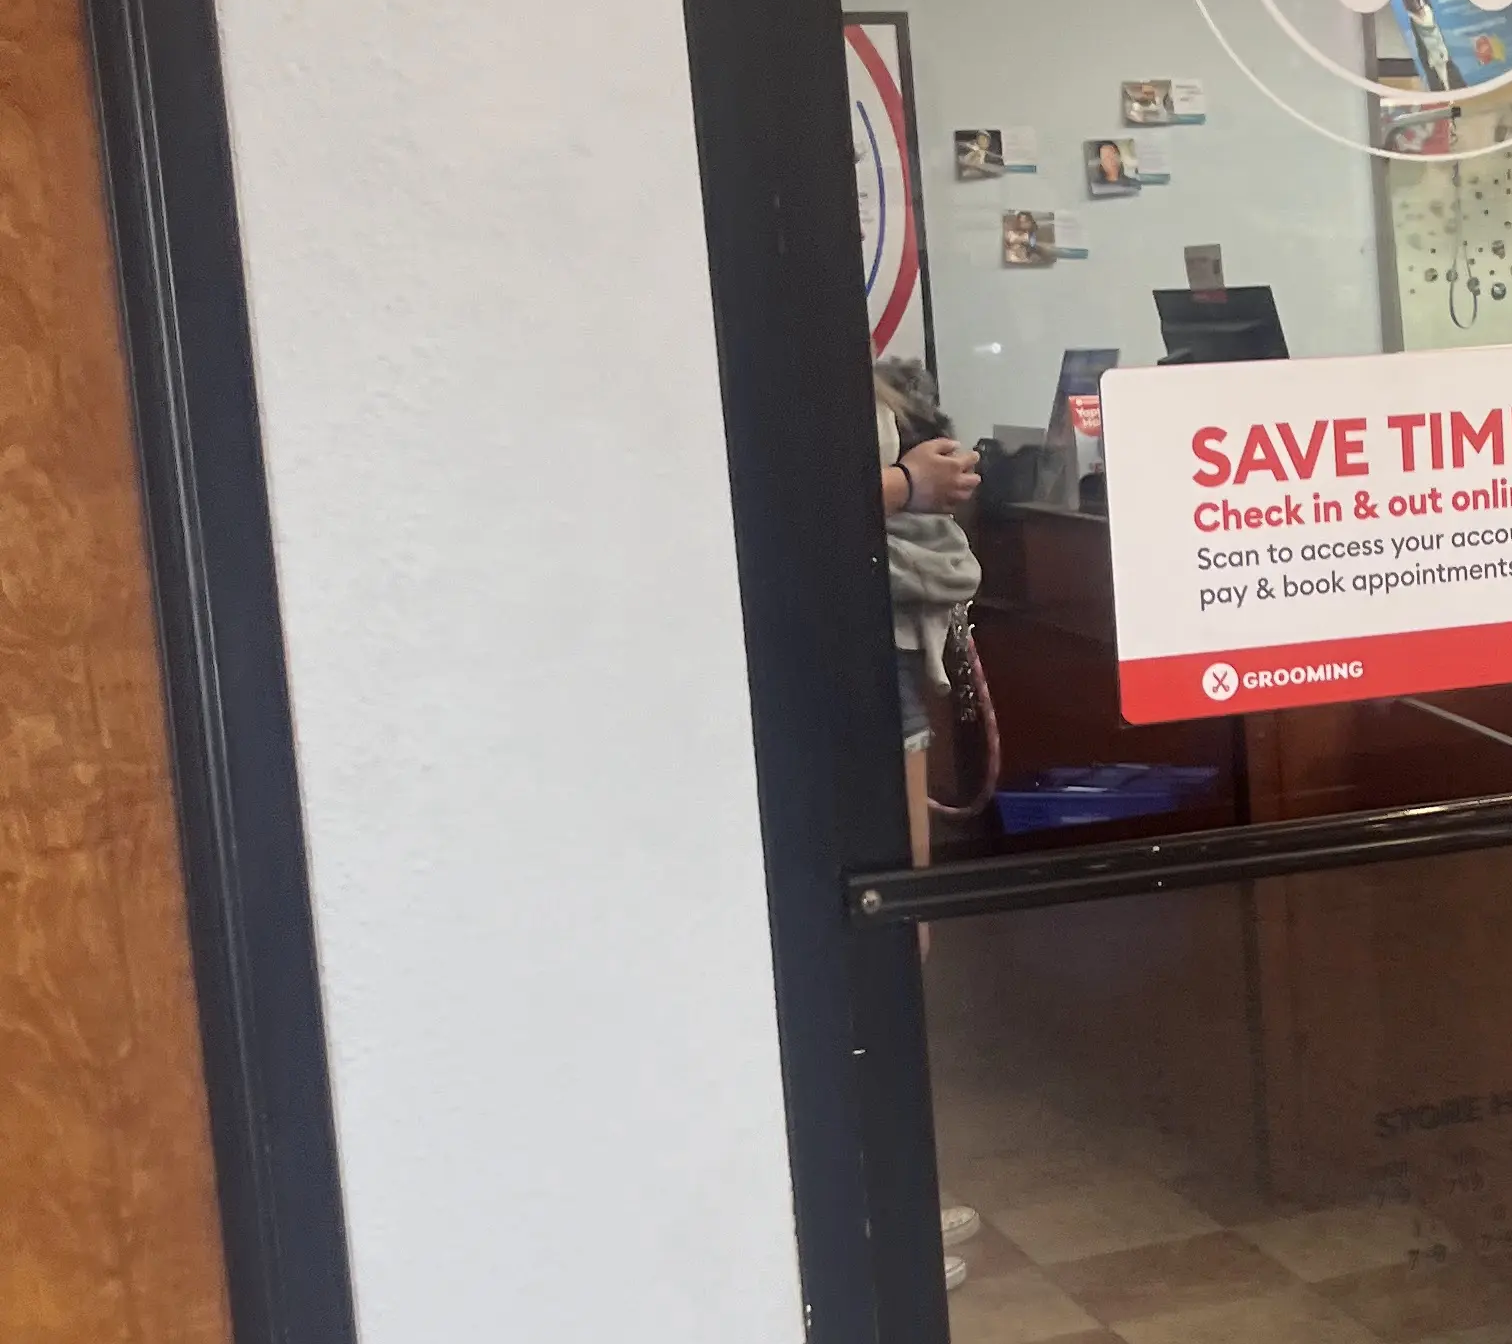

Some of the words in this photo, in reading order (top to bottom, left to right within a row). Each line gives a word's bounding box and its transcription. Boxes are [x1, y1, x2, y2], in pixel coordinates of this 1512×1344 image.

[1191, 416, 1370, 489] SAVE
[1193, 494, 1306, 533] Check
[1312, 491, 1344, 524] in
[1352, 489, 1380, 521] &
[1387, 487, 1443, 517] out
[1197, 546, 1260, 571] Scan
[1266, 543, 1294, 564] to
[1300, 537, 1385, 562] access
[1390, 532, 1445, 559] your
[1199, 583, 1248, 612] pay
[1256, 577, 1277, 601] &
[1282, 570, 1347, 598] book
[1242, 660, 1365, 690] GROOMING
